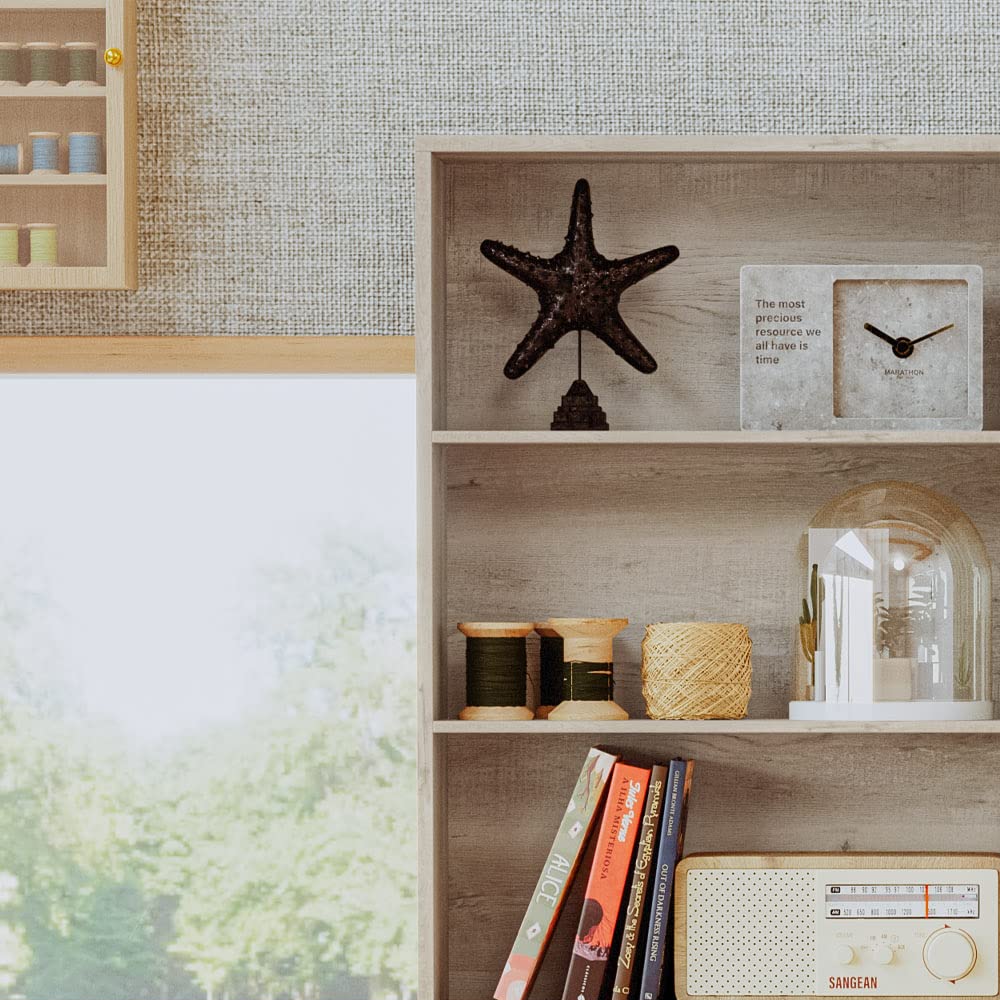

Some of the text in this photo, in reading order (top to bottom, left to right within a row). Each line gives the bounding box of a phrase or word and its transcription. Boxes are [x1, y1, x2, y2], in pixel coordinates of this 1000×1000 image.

[755, 300, 806, 308] The most
[755, 314, 802, 324] precious
[755, 328, 822, 337] resource we
[755, 340, 808, 350] all have is
[755, 355, 780, 364] time
[614, 786, 628, 812] ILHA
[600, 814, 620, 880] MISTERIOSA
[536, 853, 570, 907] ALICE
[650, 864, 669, 962] OUT OF DARKNESS RISING
[829, 976, 878, 989] SANGEAN
